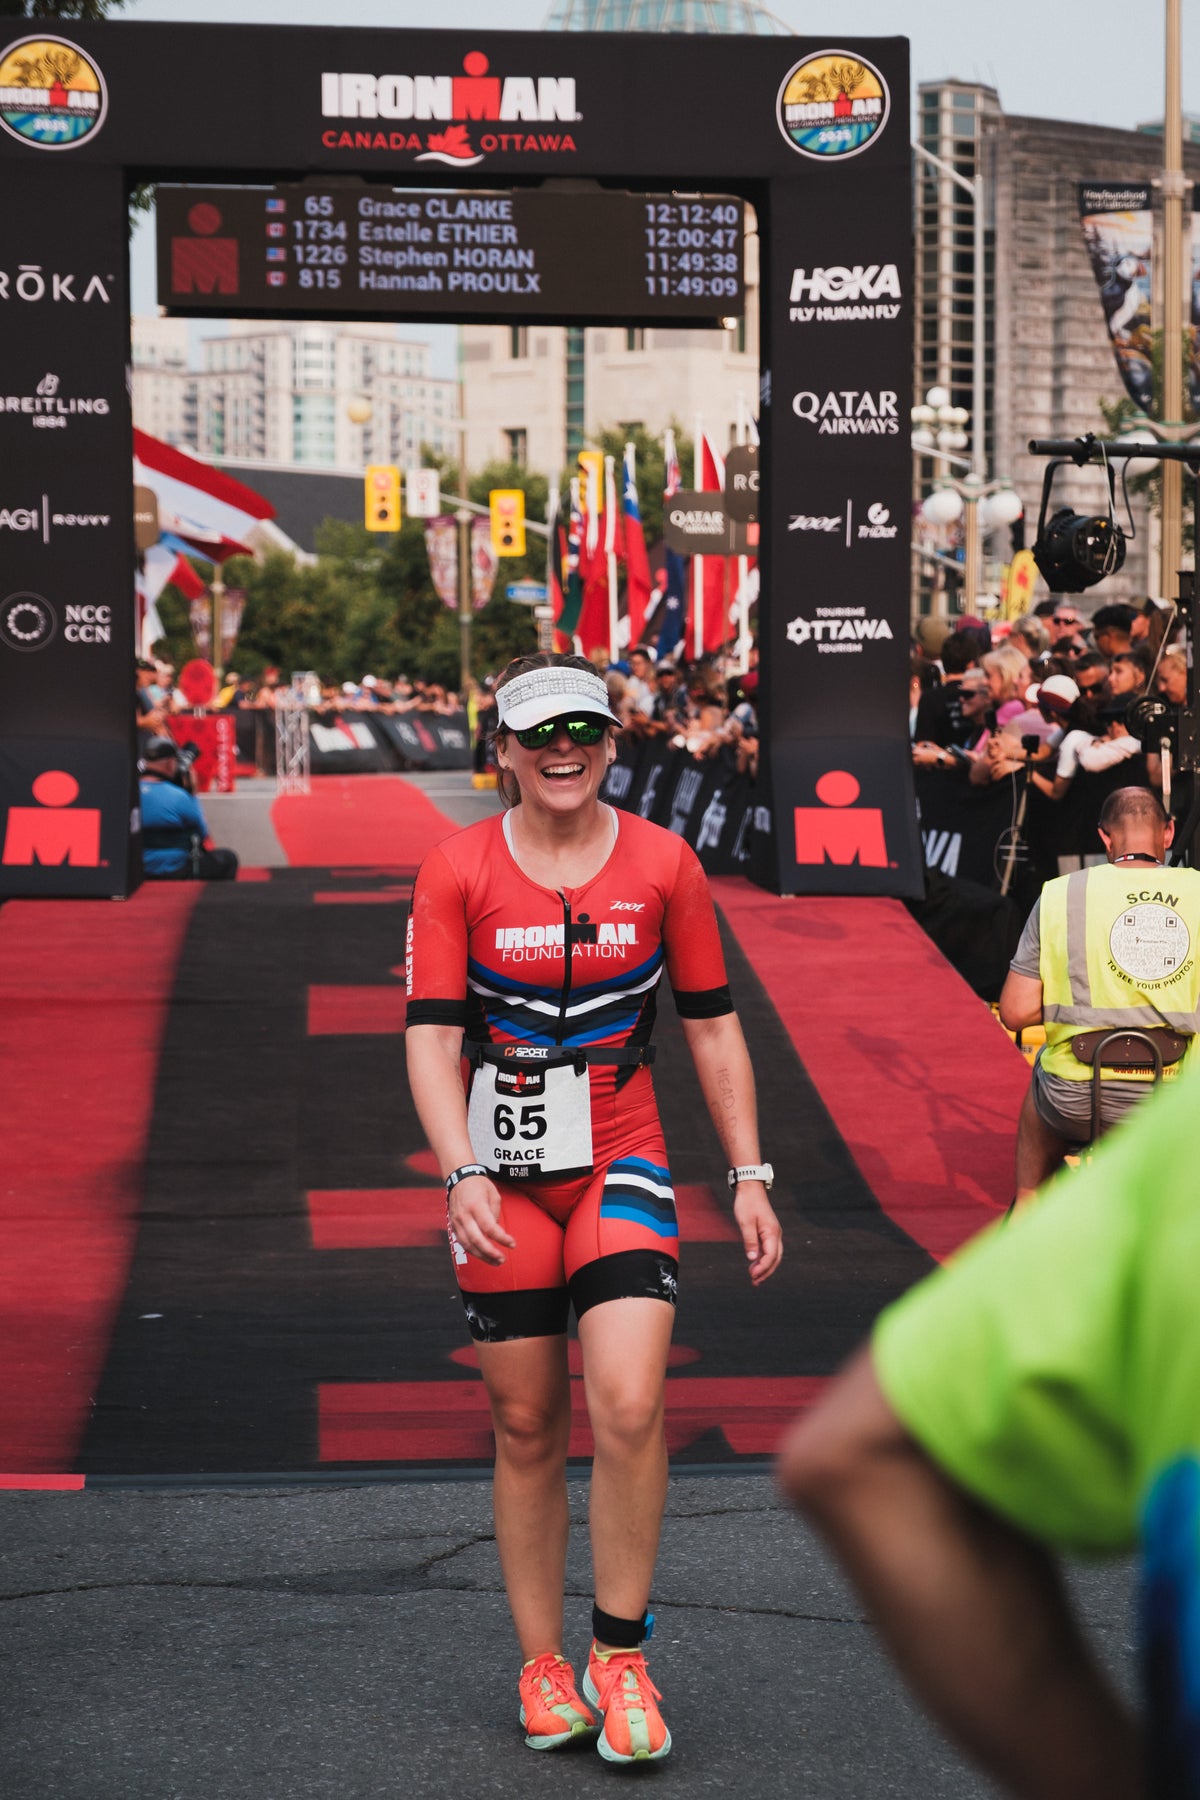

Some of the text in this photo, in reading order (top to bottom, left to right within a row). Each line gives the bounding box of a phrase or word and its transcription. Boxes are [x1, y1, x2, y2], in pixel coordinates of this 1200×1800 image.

[321, 51, 576, 121] IRONMAN
[321, 130, 577, 151] CANADA OTTAWA
[818, 129, 852, 143] 2025
[304, 196, 738, 225] 65 Grace CLARKE 12:12:40
[293, 220, 738, 249] 1734 Estelle ETHIER 12:00:47
[293, 244, 738, 273] 1226 Stephen HORAN 11:49:38
[298, 268, 738, 297] 815 Hannah PROULX 11:49:09
[789, 264, 902, 302] HOKA
[789, 304, 901, 322] FLY HUMAN FLY
[792, 391, 899, 423] QATAR
[818, 417, 900, 434] AIRWAYS
[0, 508, 39, 531] AG1
[669, 509, 724, 529] QATAR
[65, 604, 112, 624] NCC
[64, 624, 112, 643] CCN
[786, 617, 894, 645] OTTAWA
[1126, 891, 1179, 907] SCAN
[495, 913, 636, 949] IRONMAN
[405, 917, 415, 996] RACE FOR
[502, 944, 626, 962] FOUNDATION
[1107, 959, 1194, 990] TO SEE YOUR PHOTOS
[497, 1071, 541, 1085] IRONMAN
[494, 1103, 547, 1141] 65
[494, 1147, 545, 1161] GRACE
